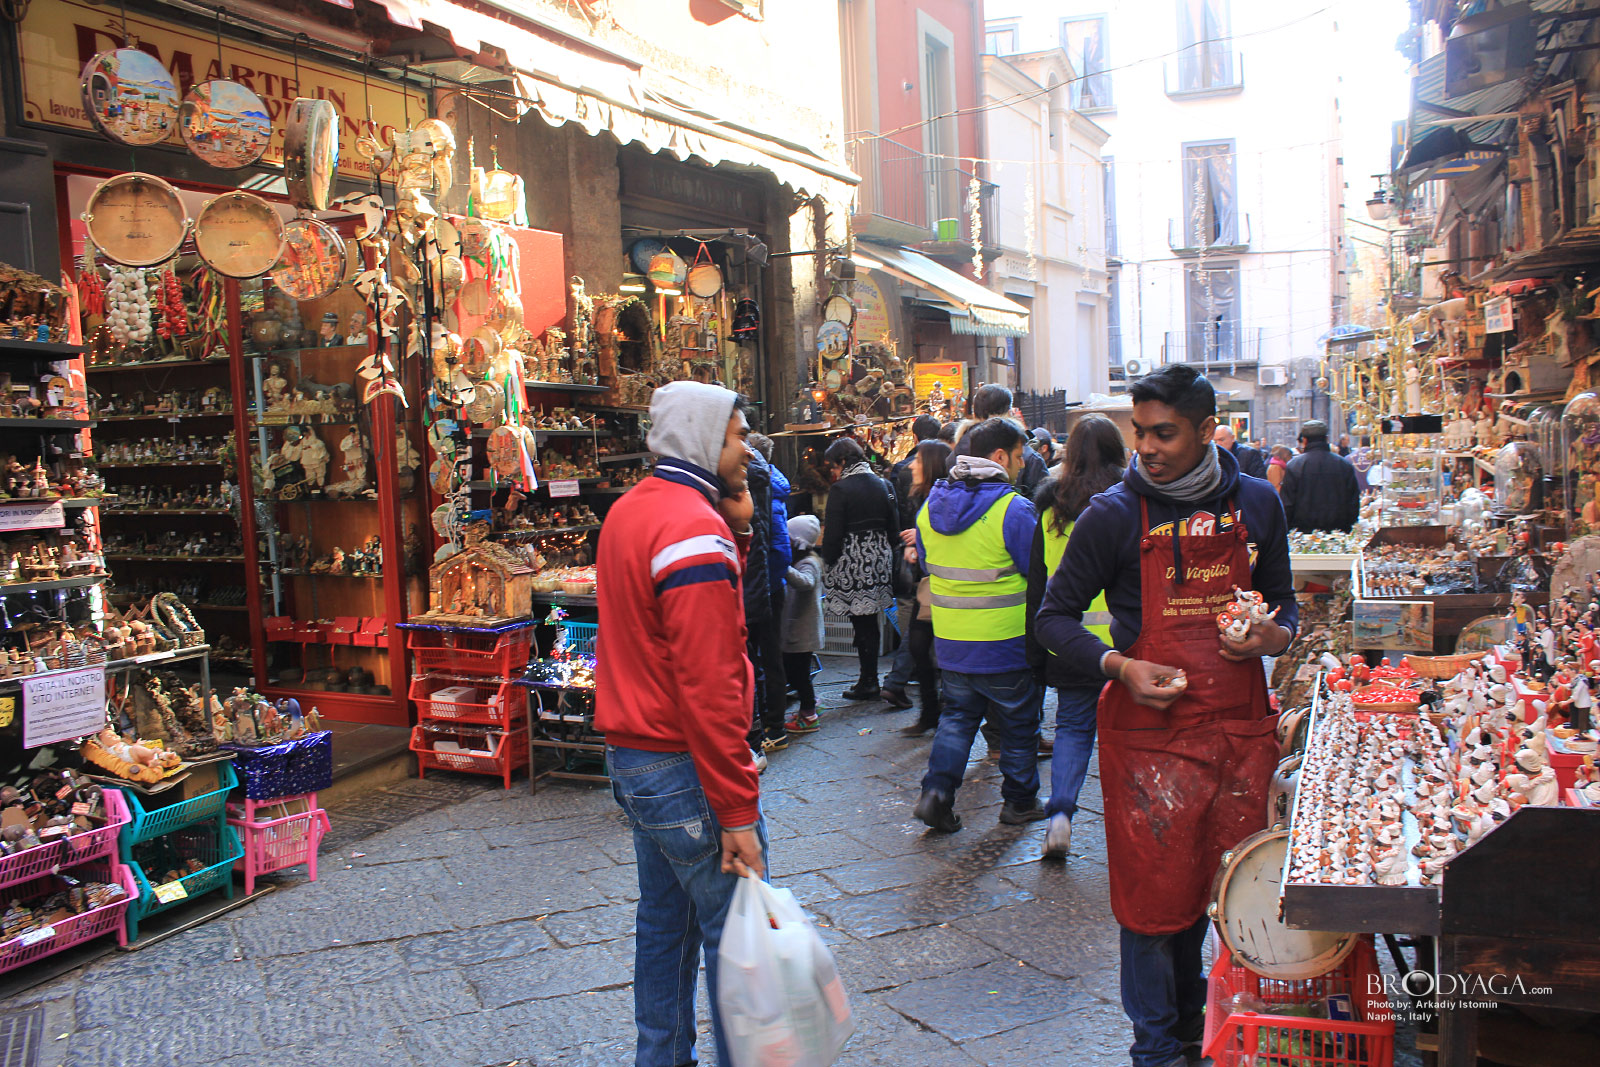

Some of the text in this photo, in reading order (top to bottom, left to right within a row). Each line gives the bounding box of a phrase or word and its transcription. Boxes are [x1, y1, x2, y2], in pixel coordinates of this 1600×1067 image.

[204, 59, 300, 100] ARTE
[316, 85, 346, 114] IN
[49, 98, 89, 122] lavora
[1187, 564, 1230, 582] Virgilio
[28, 680, 57, 693] VISITA
[68, 672, 102, 687] NOSTRO
[32, 685, 95, 705] SITO INTERNET
